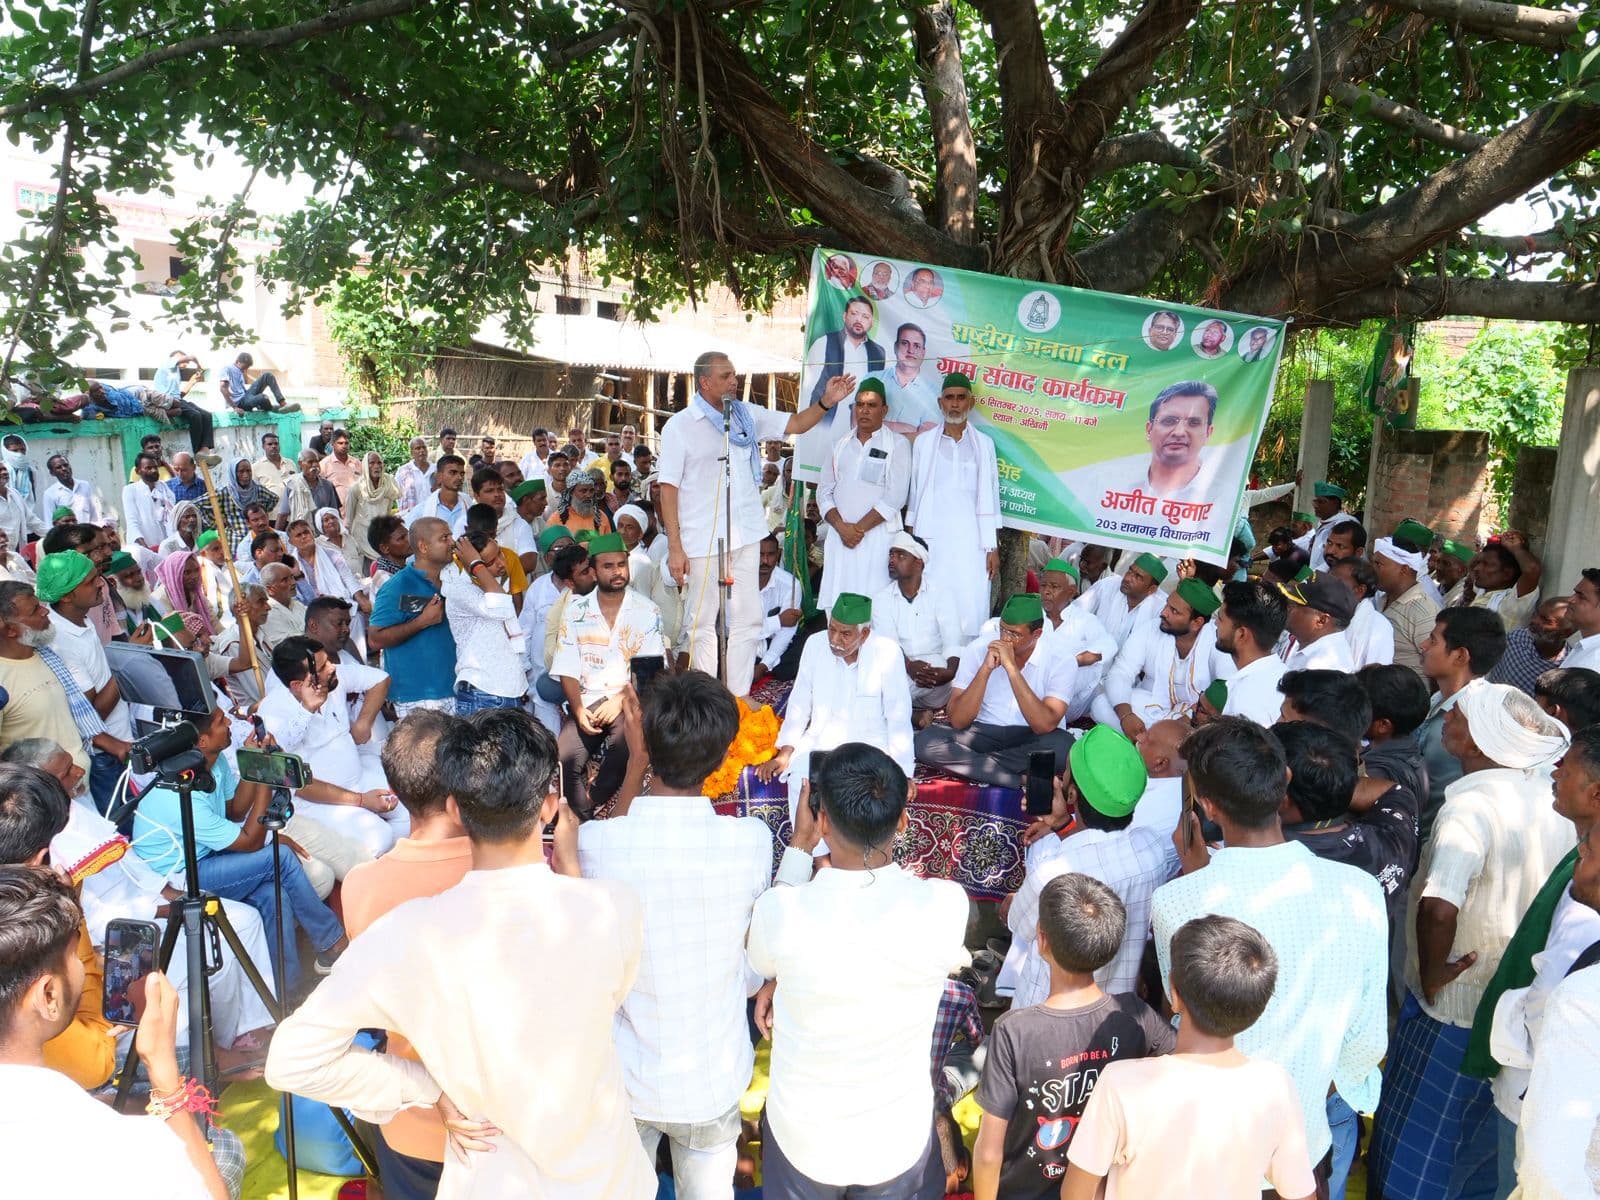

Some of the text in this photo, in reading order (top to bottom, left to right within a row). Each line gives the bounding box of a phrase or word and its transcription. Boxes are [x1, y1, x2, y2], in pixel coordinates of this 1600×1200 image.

[953, 323, 1129, 371] राष्ट्रीय जनता दल
[983, 363, 1038, 394] संवाद
[1042, 377, 1126, 409] कार्यक्रम
[980, 397, 986, 405] 6
[987, 396, 1016, 411] सितम्बर
[1075, 416, 1081, 424] 11
[1083, 416, 1097, 426] बजे
[1008, 488, 1037, 501] अध्यक्ष
[1101, 489, 1213, 525] अजीत कुमार
[1096, 518, 1117, 531] 203
[1120, 522, 1158, 538] रामगढ़
[1060, 1050, 1108, 1070] BORN TO BE A
[1042, 1069, 1099, 1113] STA
